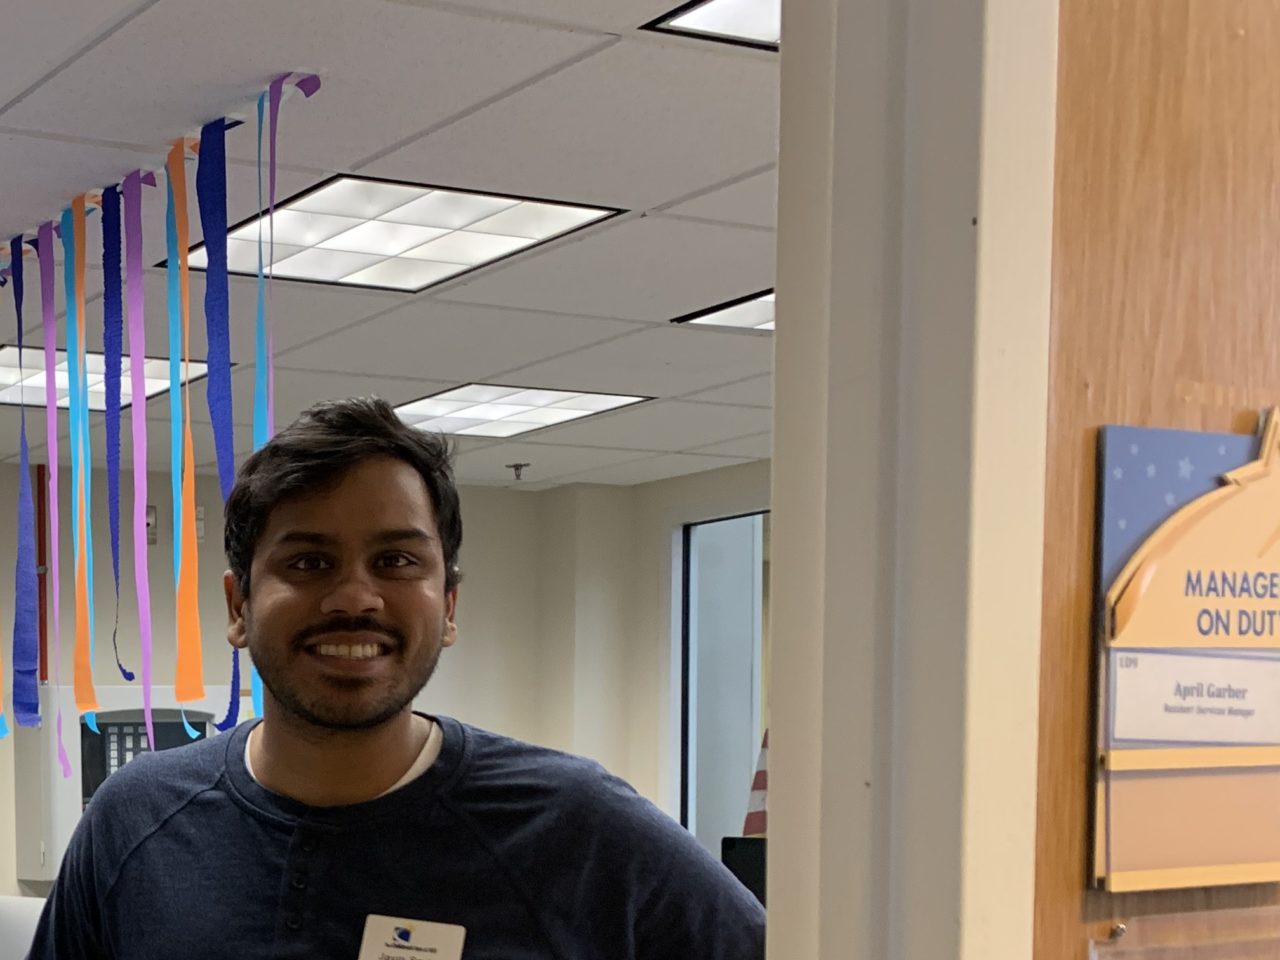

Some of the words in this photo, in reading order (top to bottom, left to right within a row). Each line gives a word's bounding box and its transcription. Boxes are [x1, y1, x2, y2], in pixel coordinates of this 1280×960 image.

[1196, 608, 1231, 636] ON
[1238, 608, 1280, 636] DUT
[1173, 680, 1204, 701] April
[1206, 682, 1248, 700] Garber
